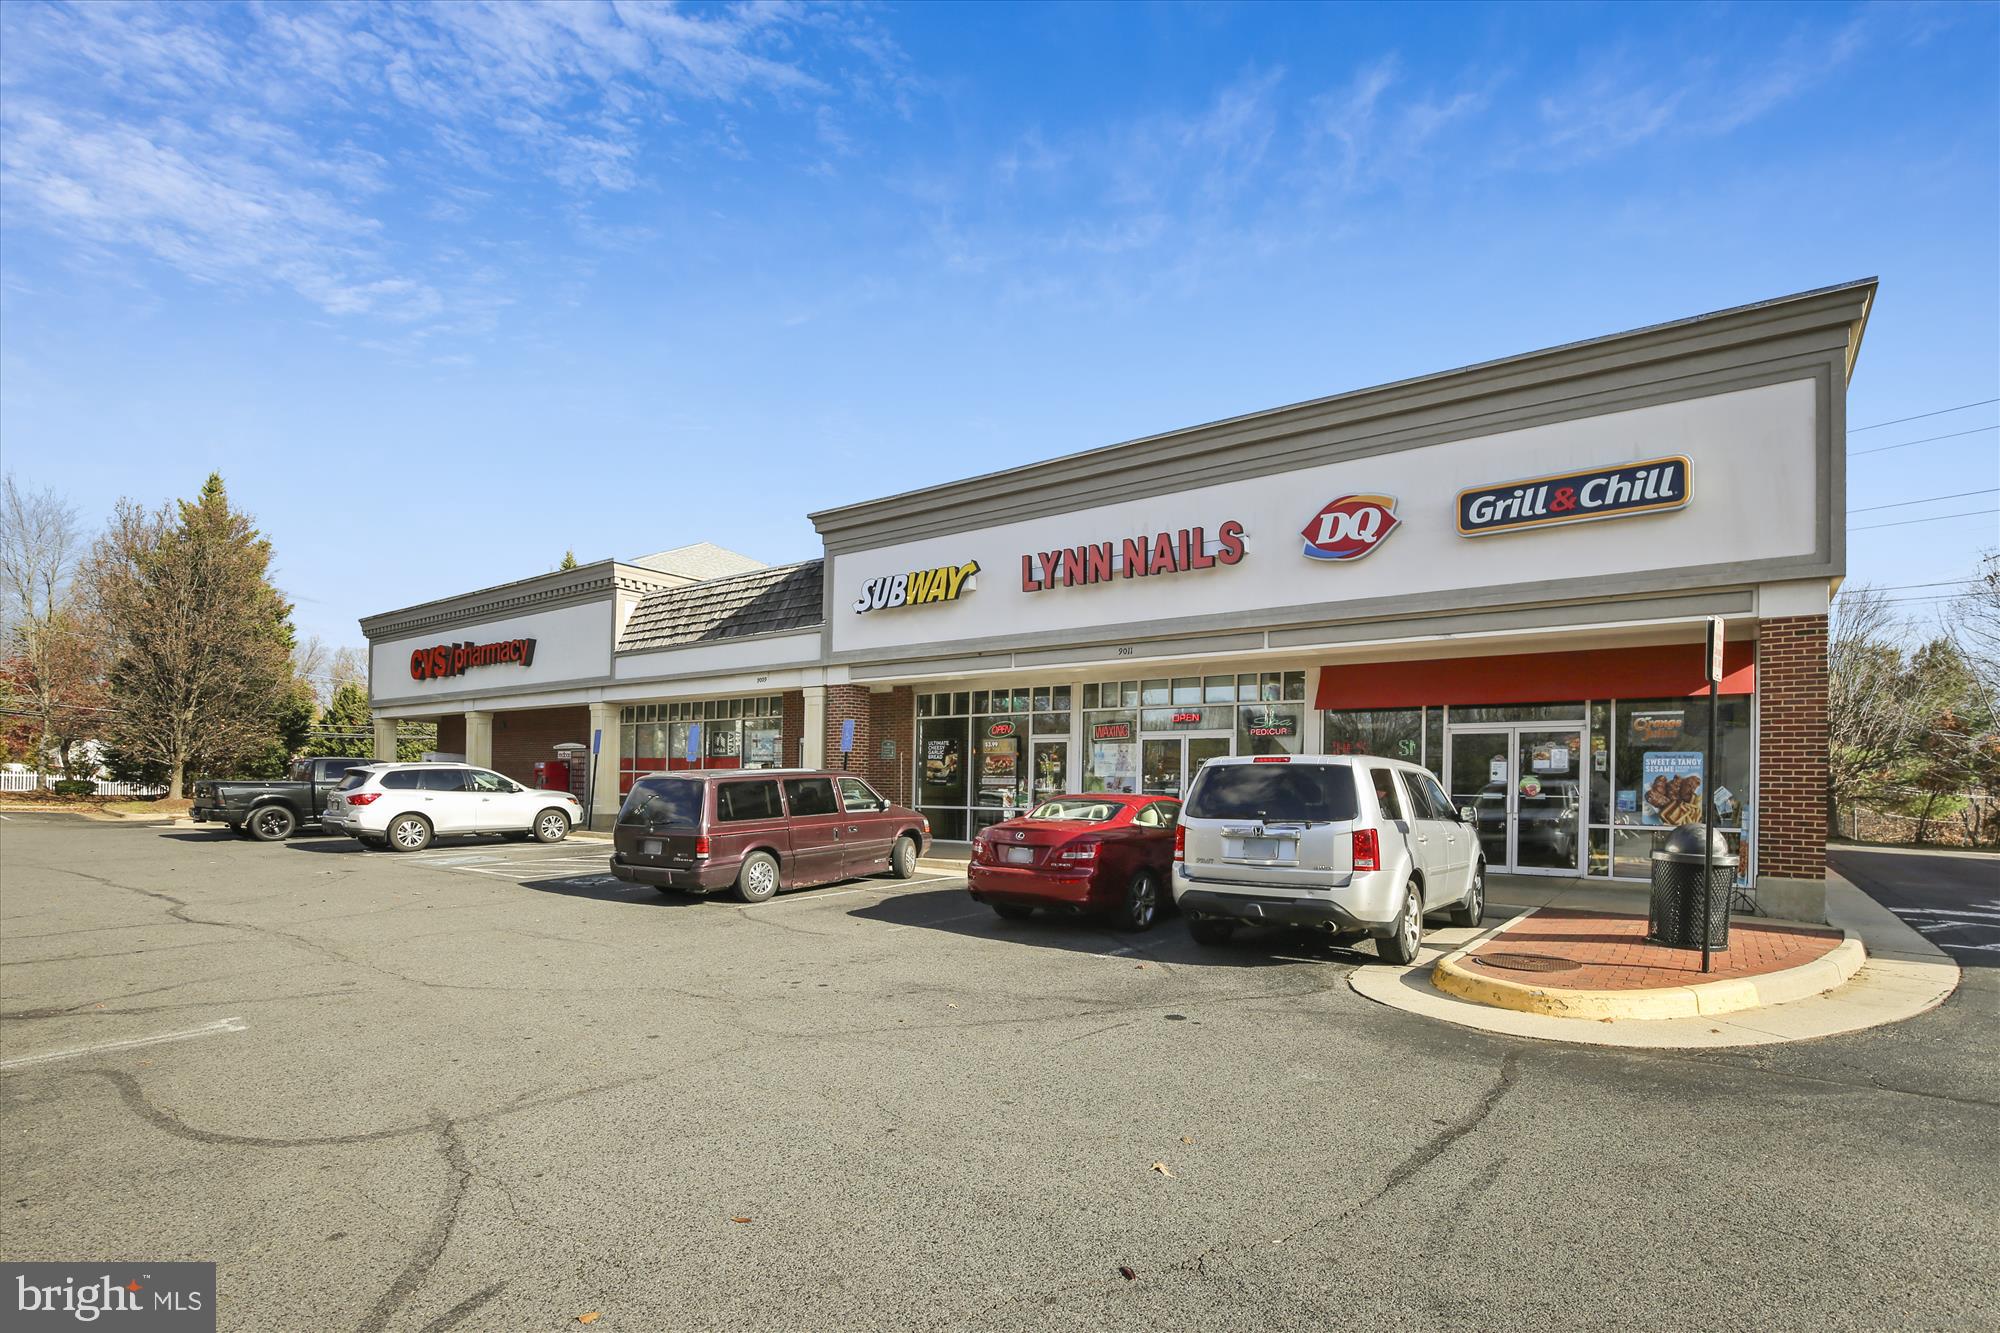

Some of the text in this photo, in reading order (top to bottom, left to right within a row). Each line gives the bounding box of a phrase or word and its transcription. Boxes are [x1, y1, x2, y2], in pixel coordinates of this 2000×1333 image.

[1469, 466, 1675, 523] Grill & Chill
[1316, 507, 1381, 544] DQ
[1022, 521, 1245, 592] LYNN NAILS
[853, 560, 981, 614] SUBWAY
[1118, 647, 1133, 656] 9011
[1171, 713, 1201, 723] OPEN
[991, 724, 1012, 736] OPEN
[1095, 724, 1129, 738] WAXING
[1677, 758, 1702, 766] TANGY
